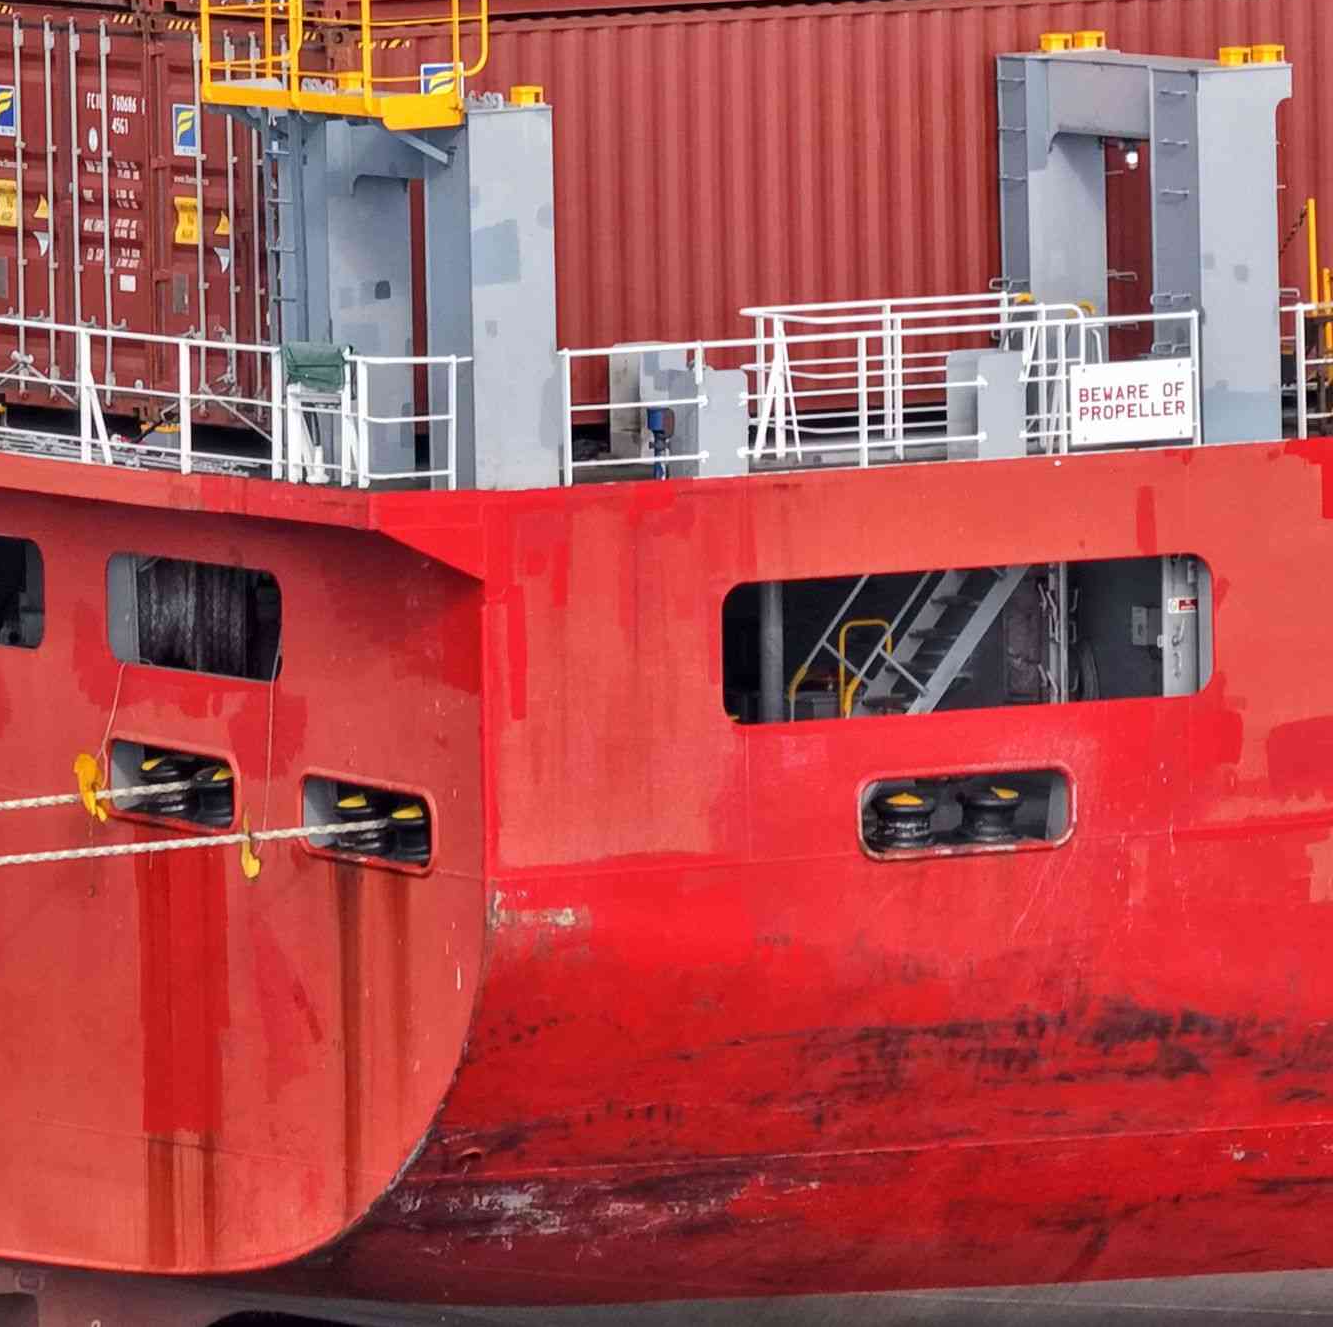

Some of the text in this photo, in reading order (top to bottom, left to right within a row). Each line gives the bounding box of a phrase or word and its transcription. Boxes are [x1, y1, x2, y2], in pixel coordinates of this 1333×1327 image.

[1079, 381, 1185, 403] BEWARE OF
[1079, 400, 1186, 421] PROPELLER
